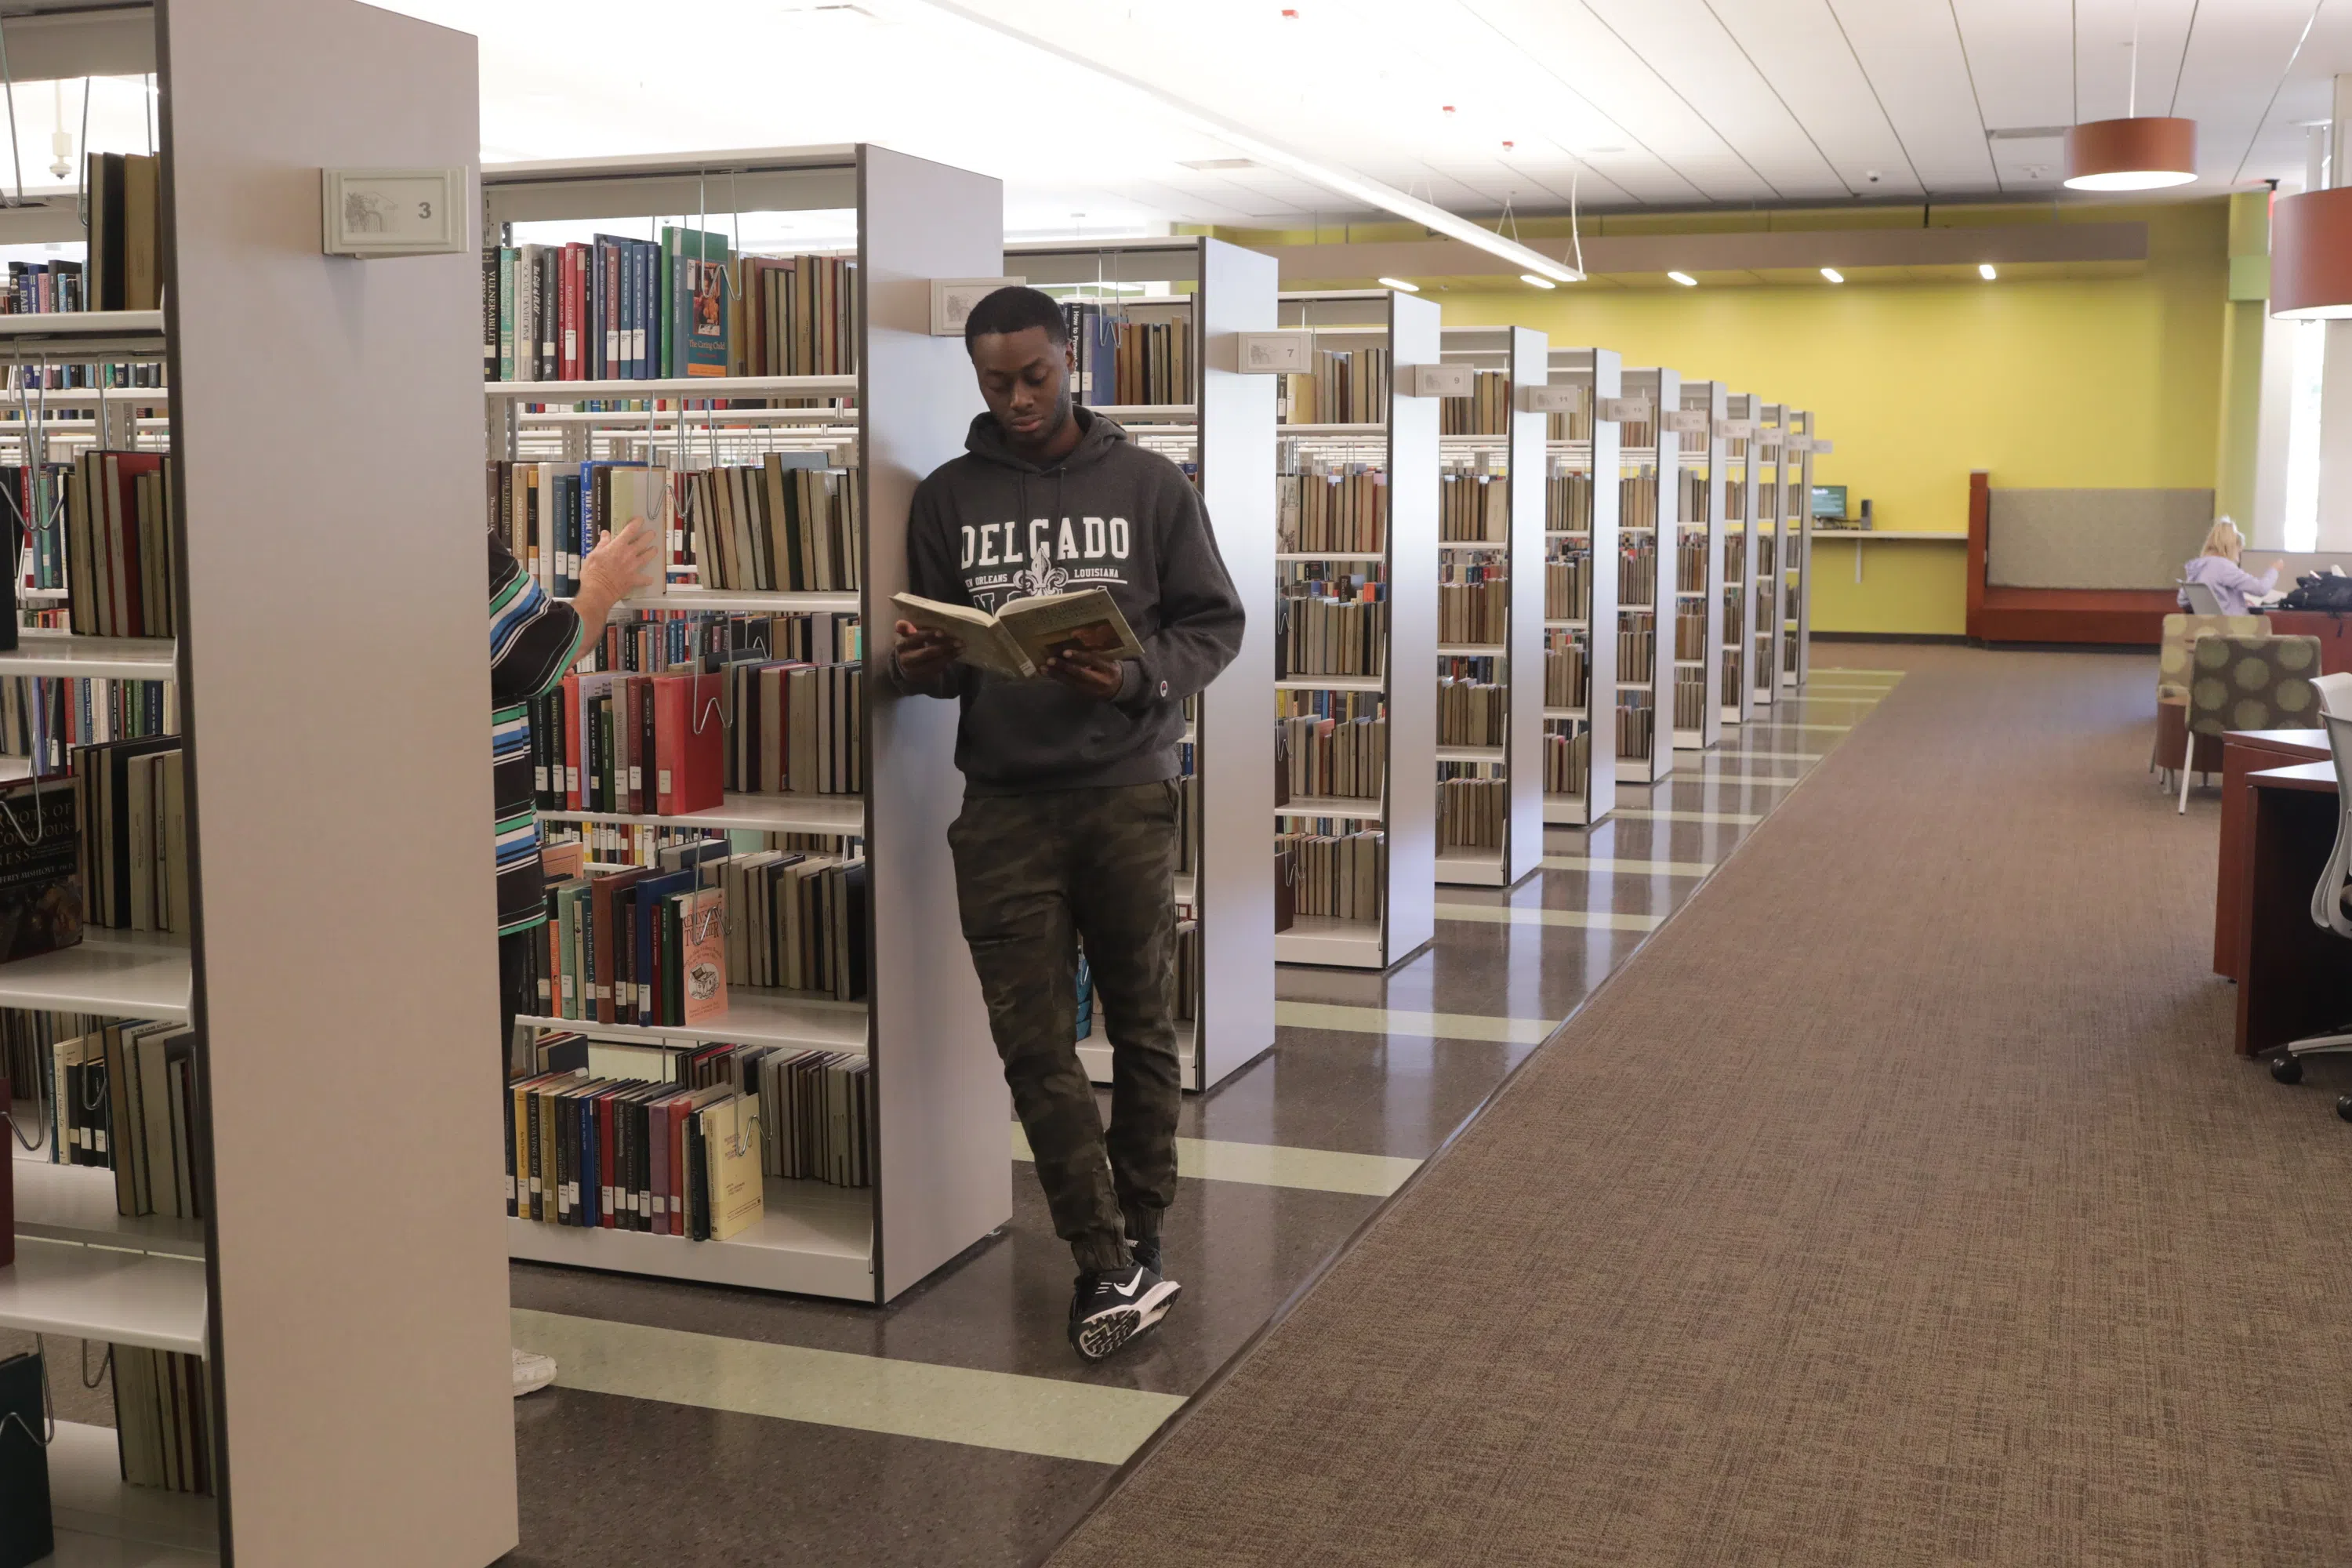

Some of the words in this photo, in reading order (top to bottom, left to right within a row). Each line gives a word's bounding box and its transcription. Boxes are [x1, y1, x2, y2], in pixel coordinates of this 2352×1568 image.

[418, 201, 431, 220] 3
[698, 340, 713, 351] Caring
[713, 341, 725, 350] Child
[1287, 348, 1294, 358] 7
[961, 517, 1130, 571] DELGADO
[975, 573, 1008, 586] ORLEANS
[1074, 568, 1120, 579] LOUISIANA
[53, 802, 72, 818] OF
[157, 1022, 172, 1030] AUTHOR
